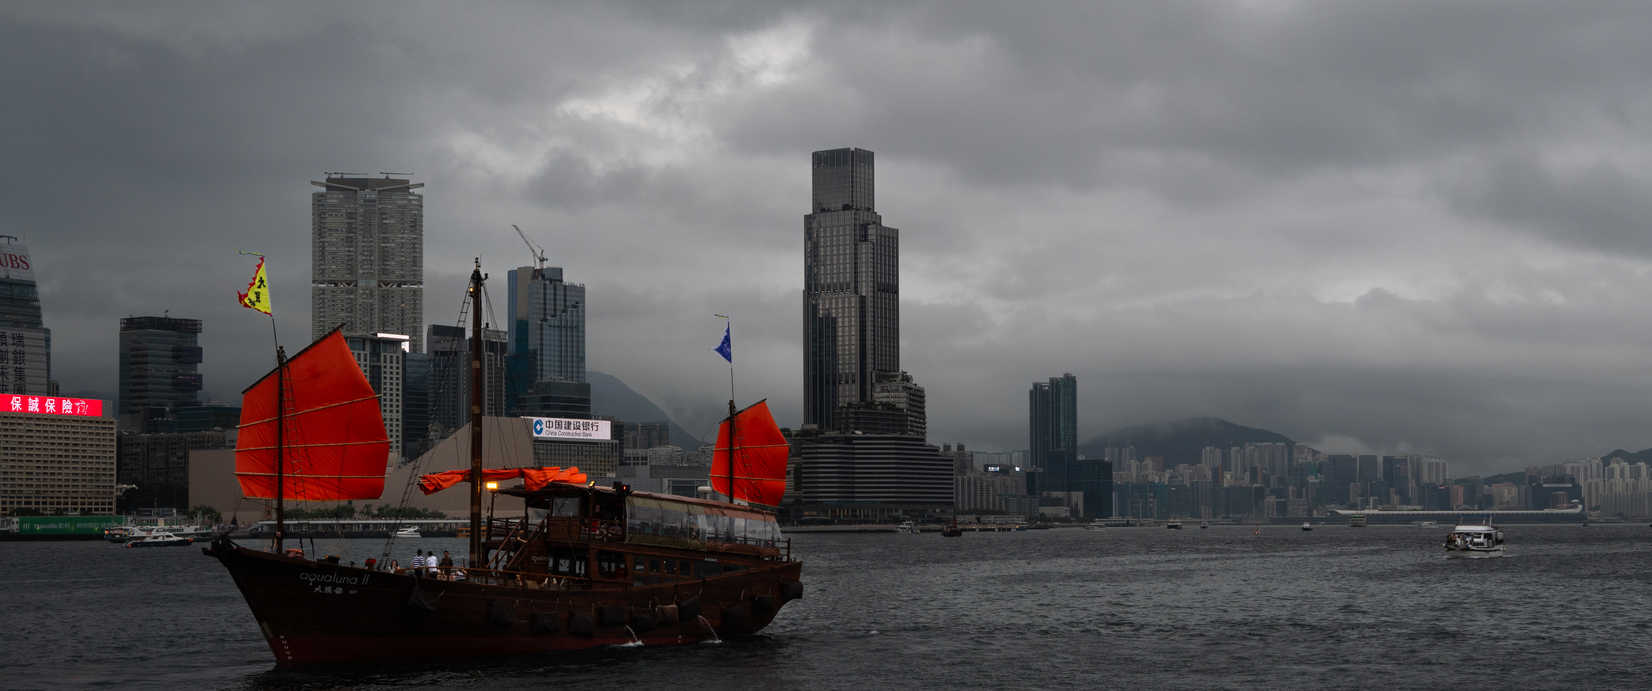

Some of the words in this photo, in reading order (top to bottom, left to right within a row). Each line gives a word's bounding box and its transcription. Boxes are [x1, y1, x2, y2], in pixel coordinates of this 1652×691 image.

[0, 253, 30, 270] UBS
[545, 419, 599, 431] 中国建设银行
[299, 571, 358, 585] aqualuna
